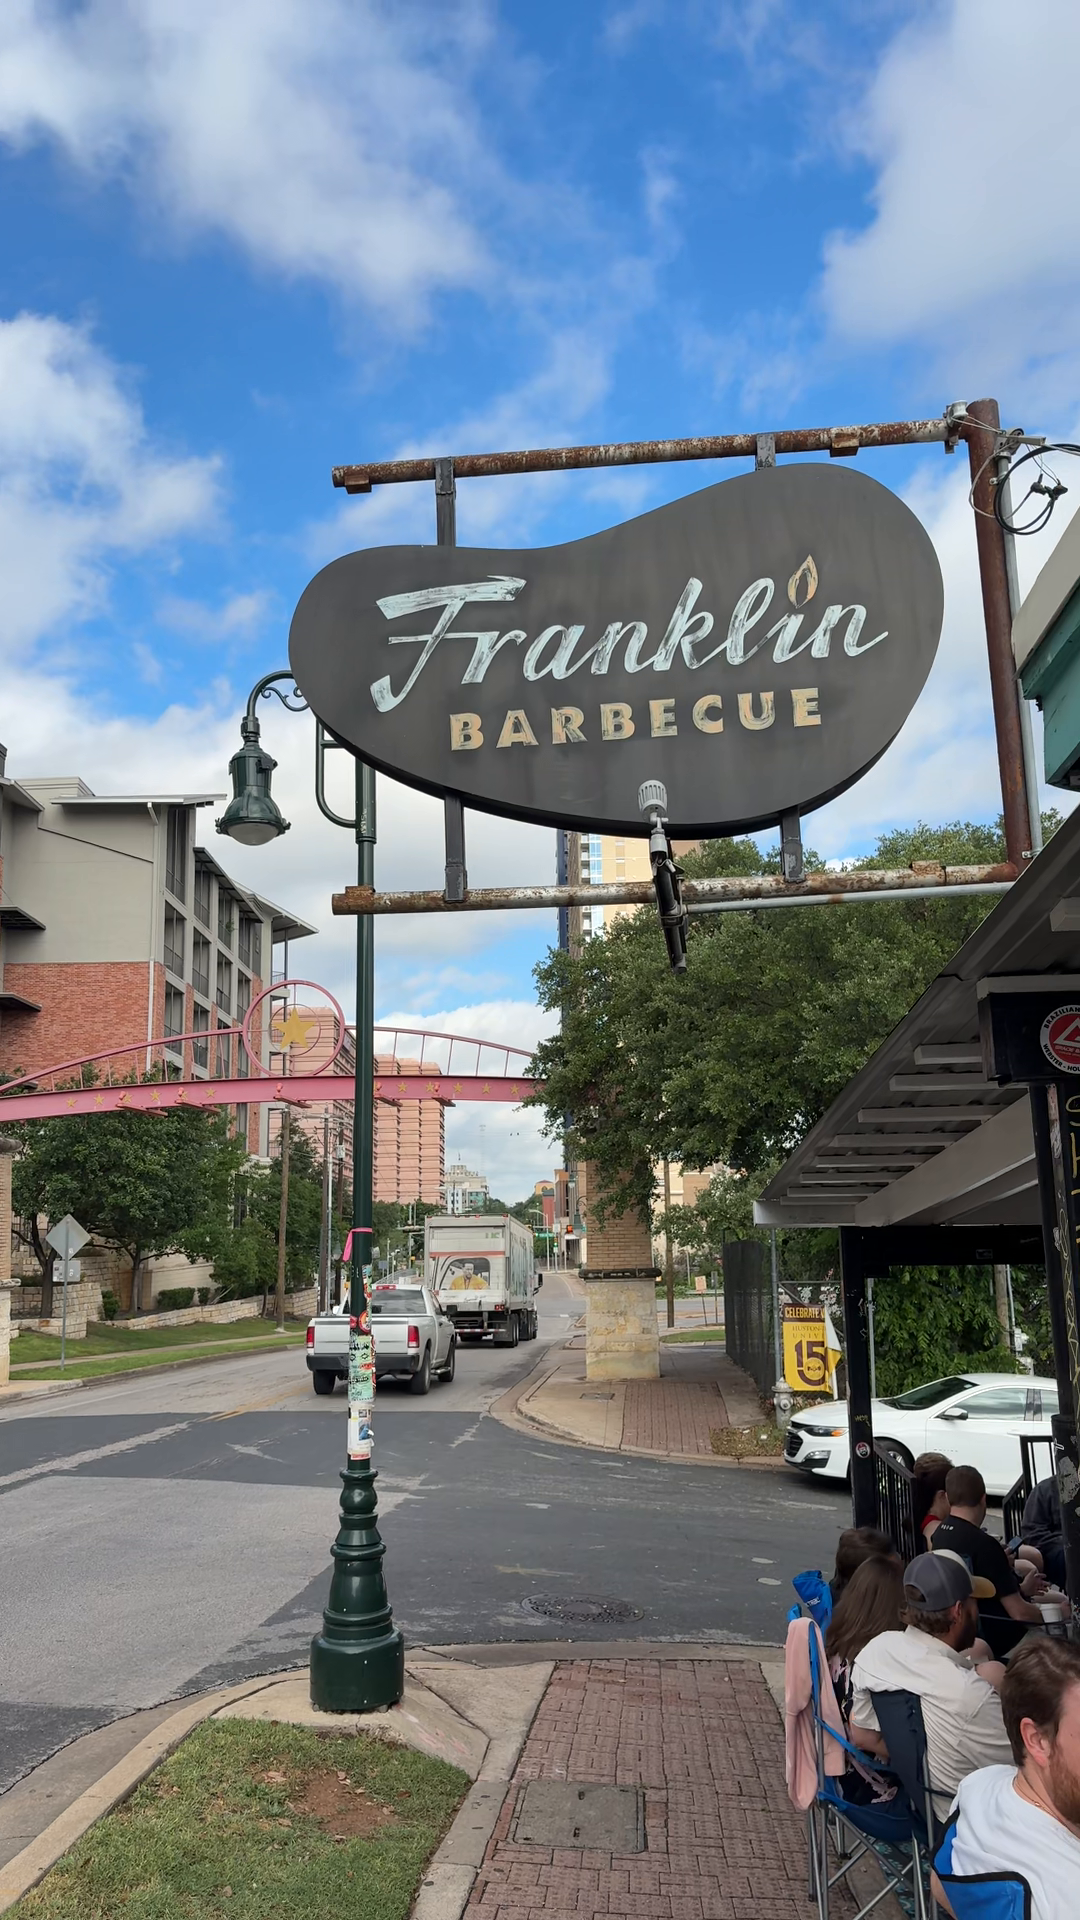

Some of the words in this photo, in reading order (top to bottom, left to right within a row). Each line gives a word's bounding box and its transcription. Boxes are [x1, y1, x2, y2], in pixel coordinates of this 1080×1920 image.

[370, 556, 889, 713] Franklin
[450, 687, 822, 751] BARBECUE
[1043, 1044, 1063, 1067] WEBSTER
[785, 1307, 820, 1319] CELEBRATE
